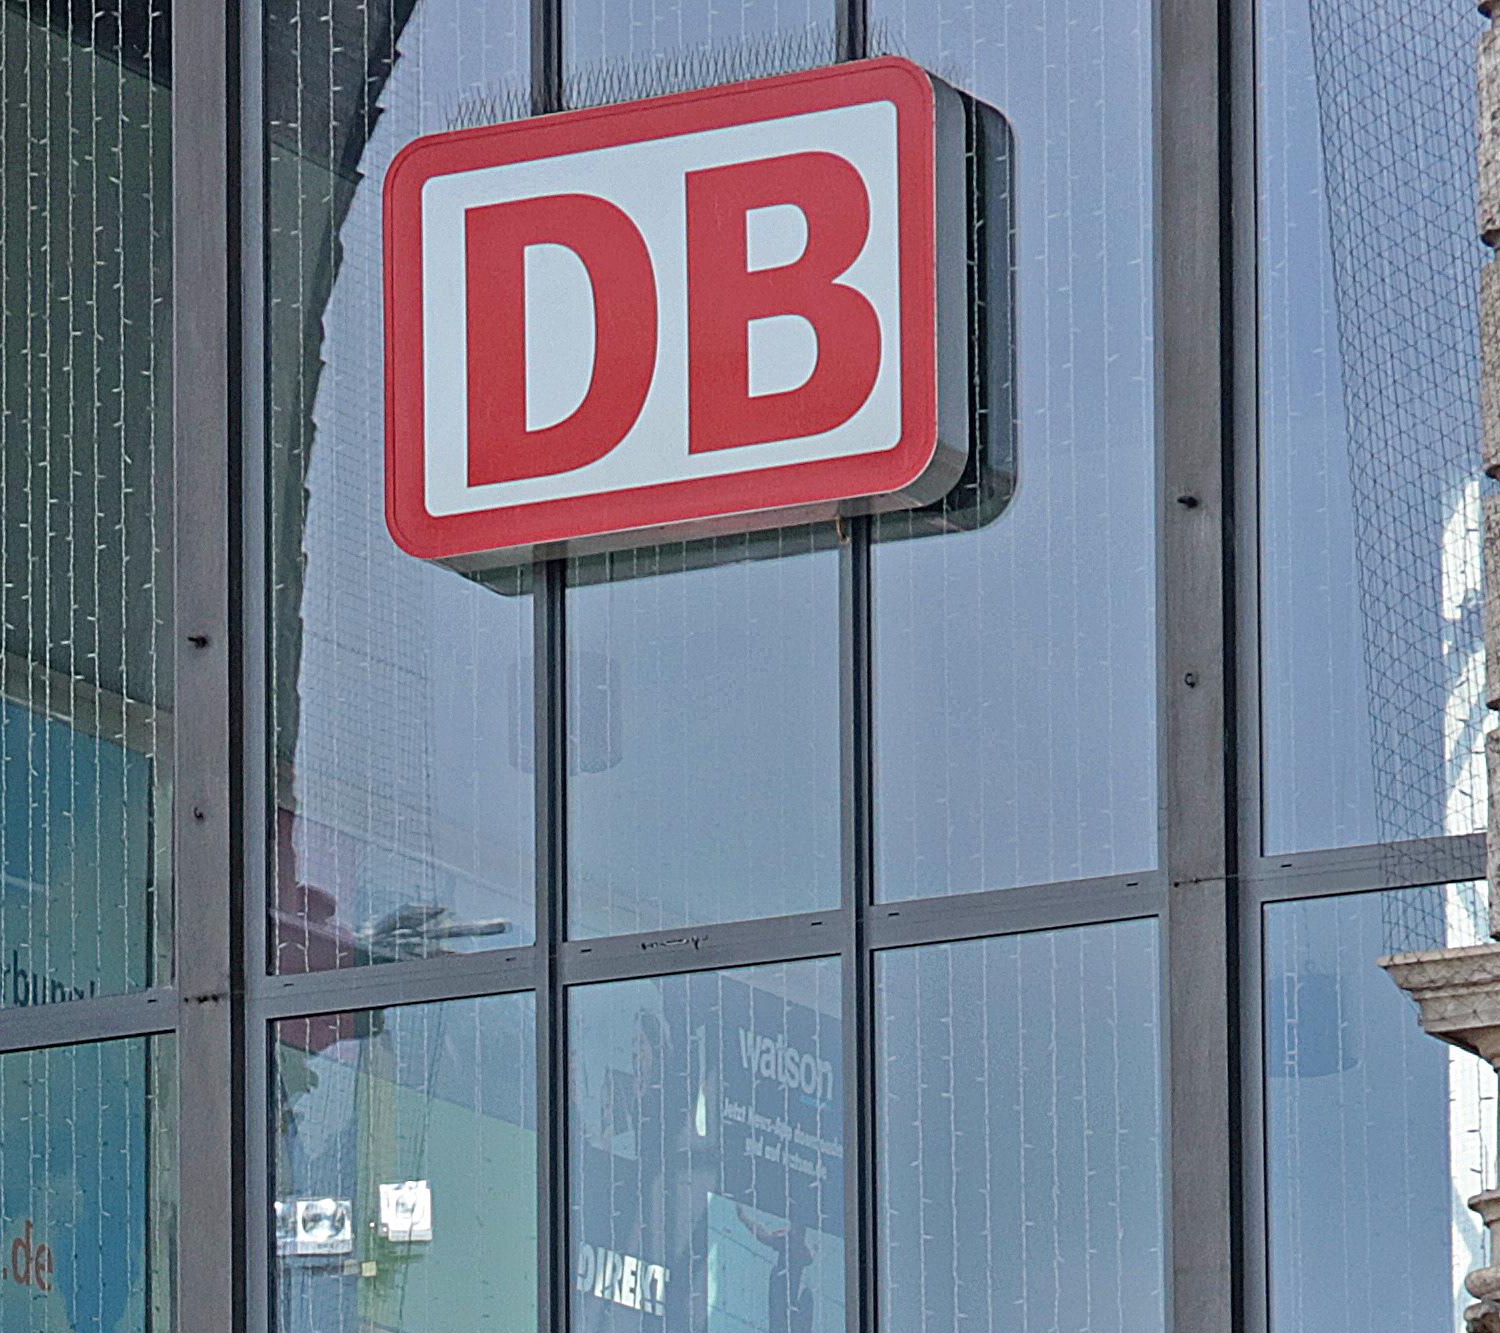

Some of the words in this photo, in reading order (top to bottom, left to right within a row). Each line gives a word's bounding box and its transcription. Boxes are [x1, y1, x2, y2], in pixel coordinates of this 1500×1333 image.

[464, 150, 882, 488] DB
[738, 1027, 835, 1101] watson
[576, 1241, 671, 1317] DIREKT
